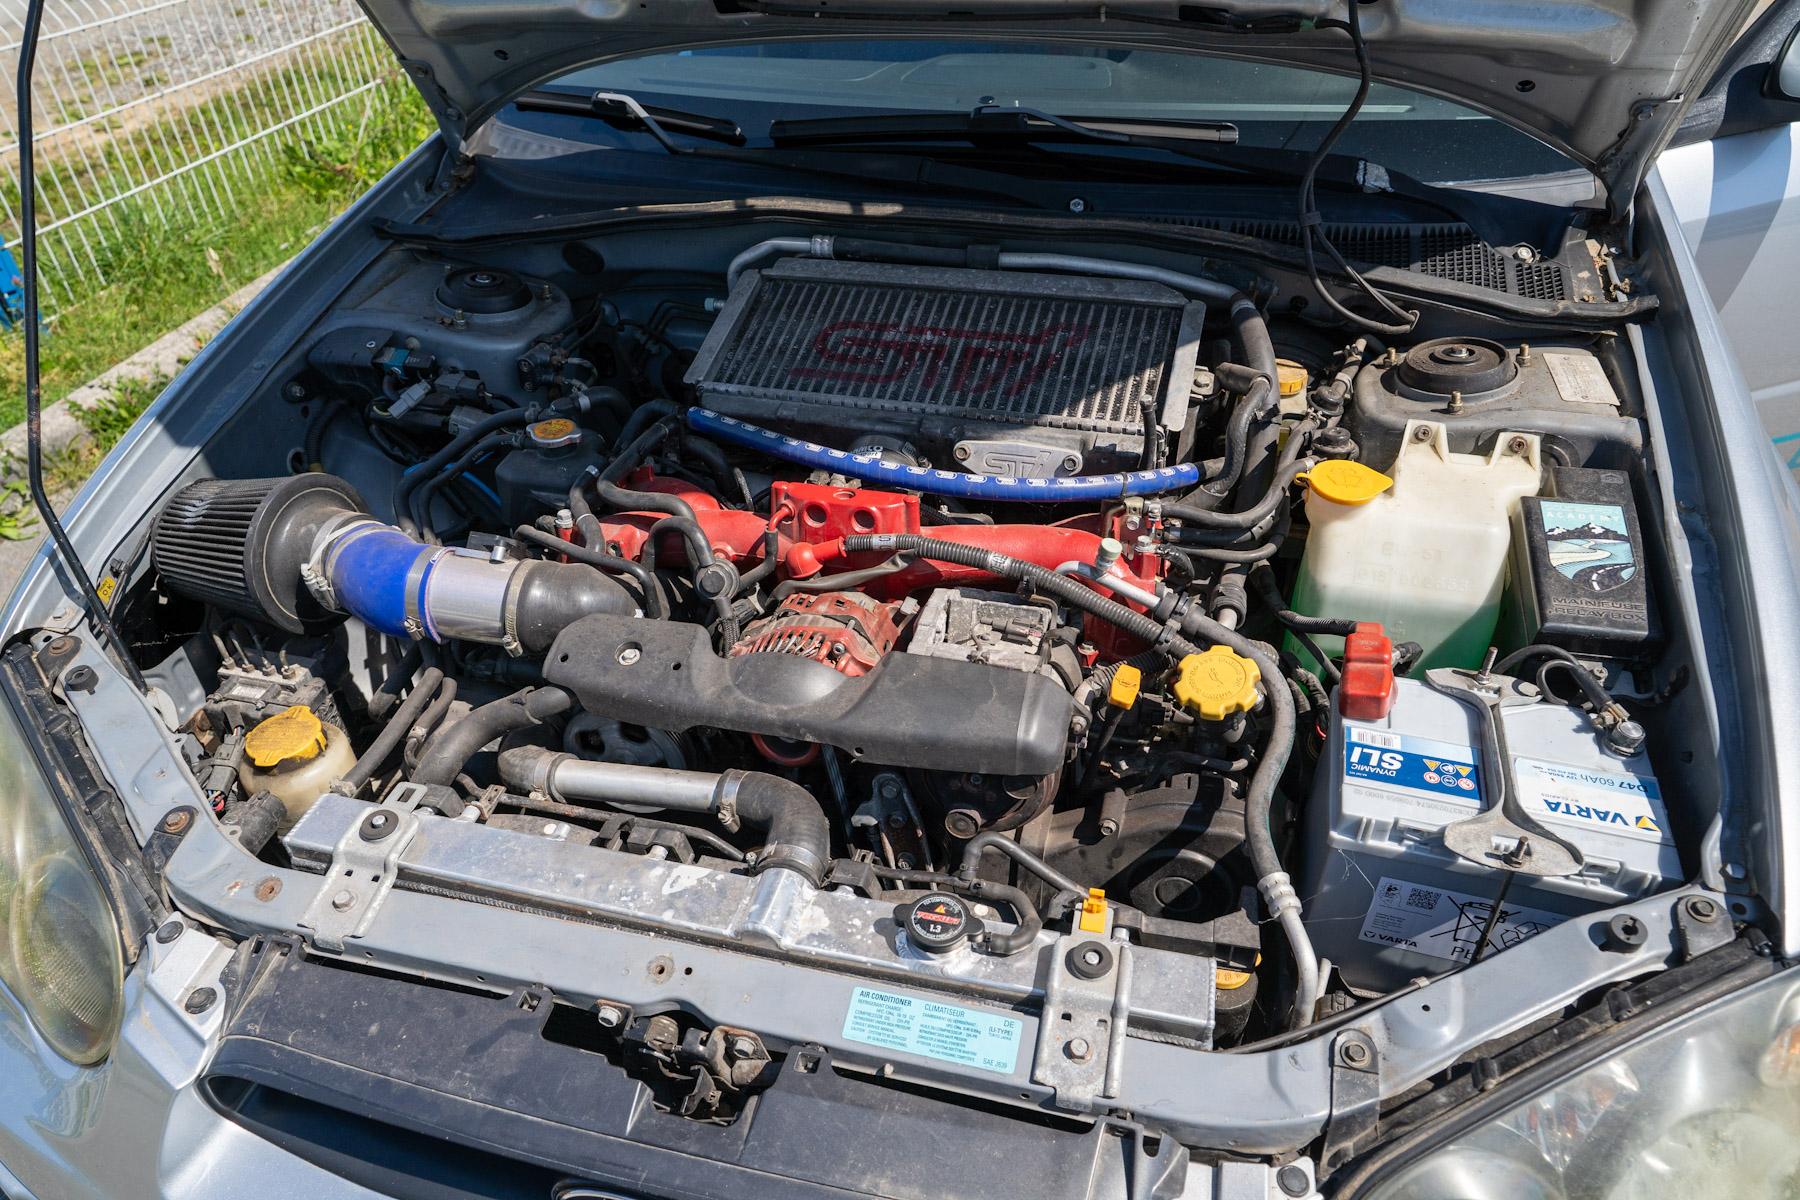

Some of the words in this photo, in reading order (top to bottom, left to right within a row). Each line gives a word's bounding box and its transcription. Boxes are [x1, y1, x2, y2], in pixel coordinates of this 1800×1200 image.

[1553, 597, 1597, 607] MAIN
[1600, 600, 1645, 610] FUSE
[1554, 607, 1606, 618] RELAY
[1611, 611, 1647, 621] BOX
[1349, 746, 1404, 770] SLI
[1350, 764, 1396, 777] DYNAMIC
[1580, 773, 1615, 786] 60Ah
[1618, 781, 1649, 792] D47
[1543, 799, 1630, 826] VARTA
[1378, 934, 1418, 948] VARTA
[860, 990, 870, 999] AIR
[871, 992, 912, 1007] CONDITIONER
[924, 1003, 965, 1018] CLIMATISEUR
[1003, 1020, 1015, 1029] DE
[983, 1058, 993, 1067] SAE
